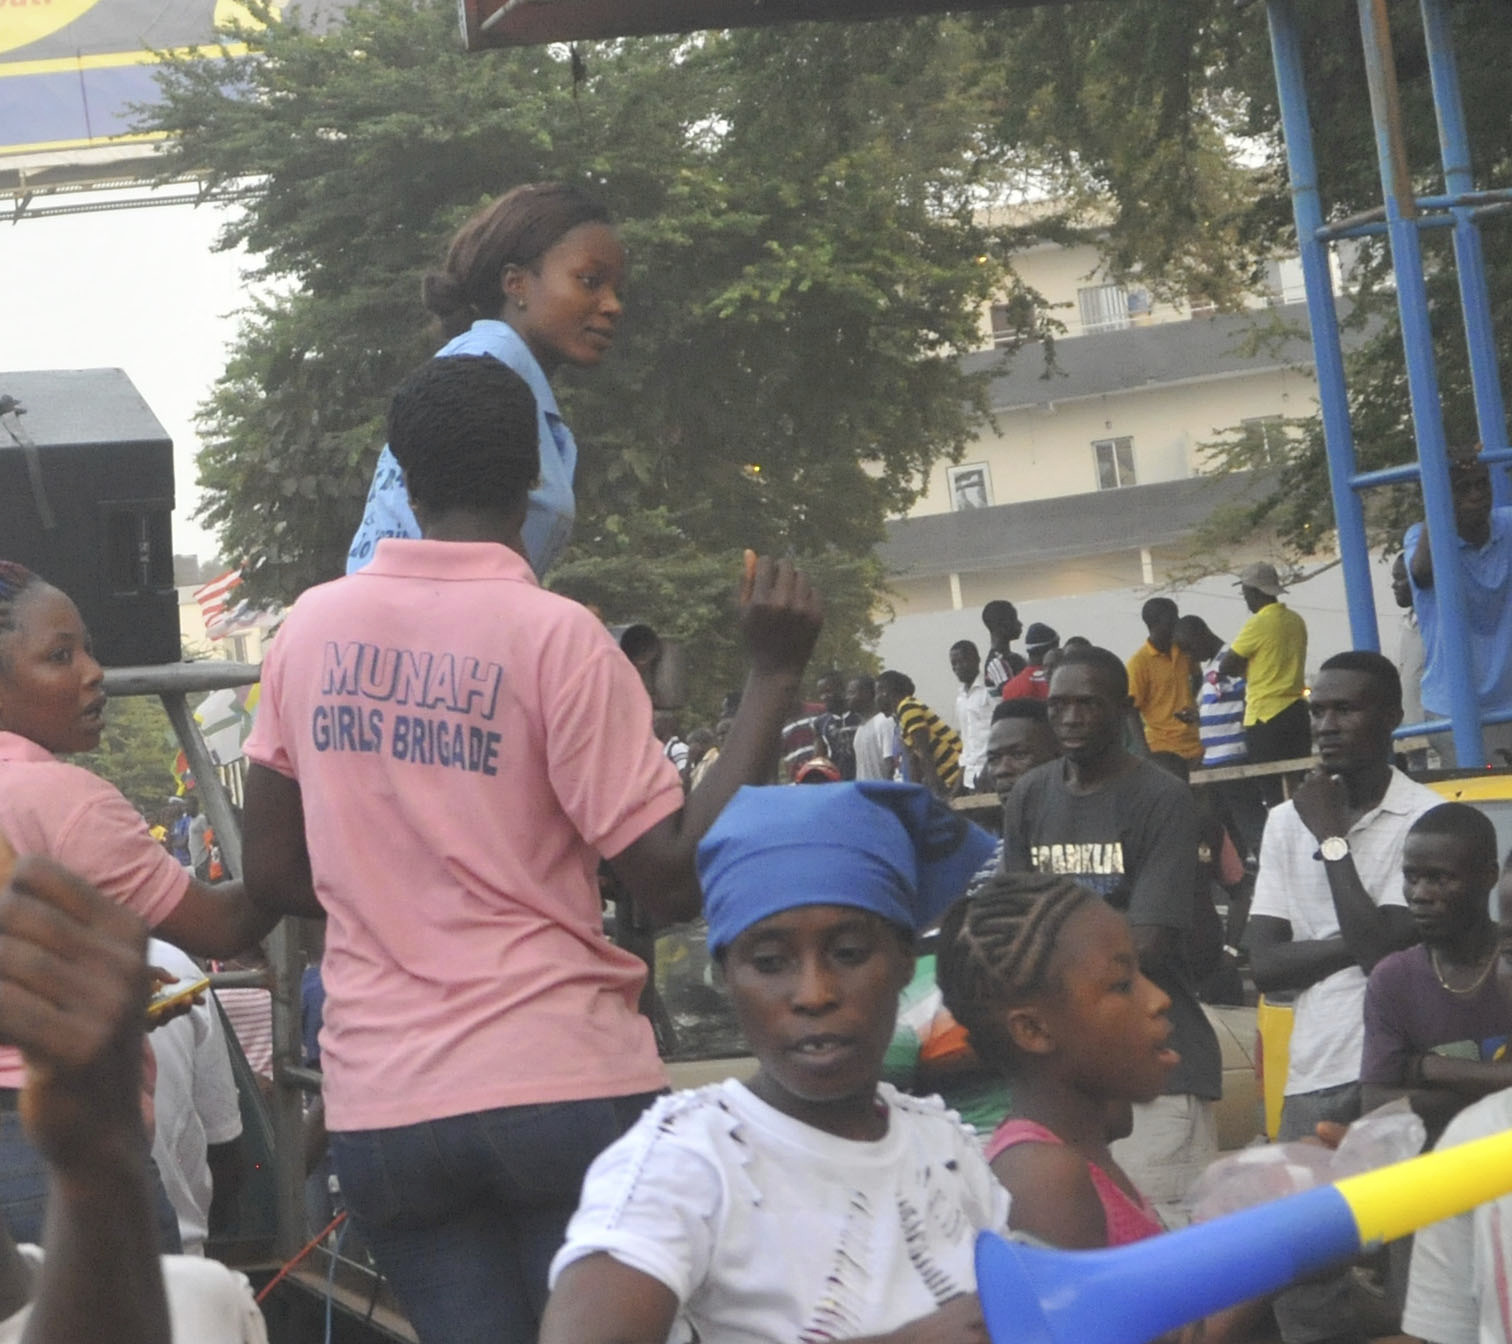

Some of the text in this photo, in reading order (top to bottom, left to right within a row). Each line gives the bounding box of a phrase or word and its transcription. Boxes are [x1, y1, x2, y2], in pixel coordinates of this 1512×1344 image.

[322, 641, 503, 720] MUNAH
[312, 705, 502, 776] GIRLS BRIGADE
